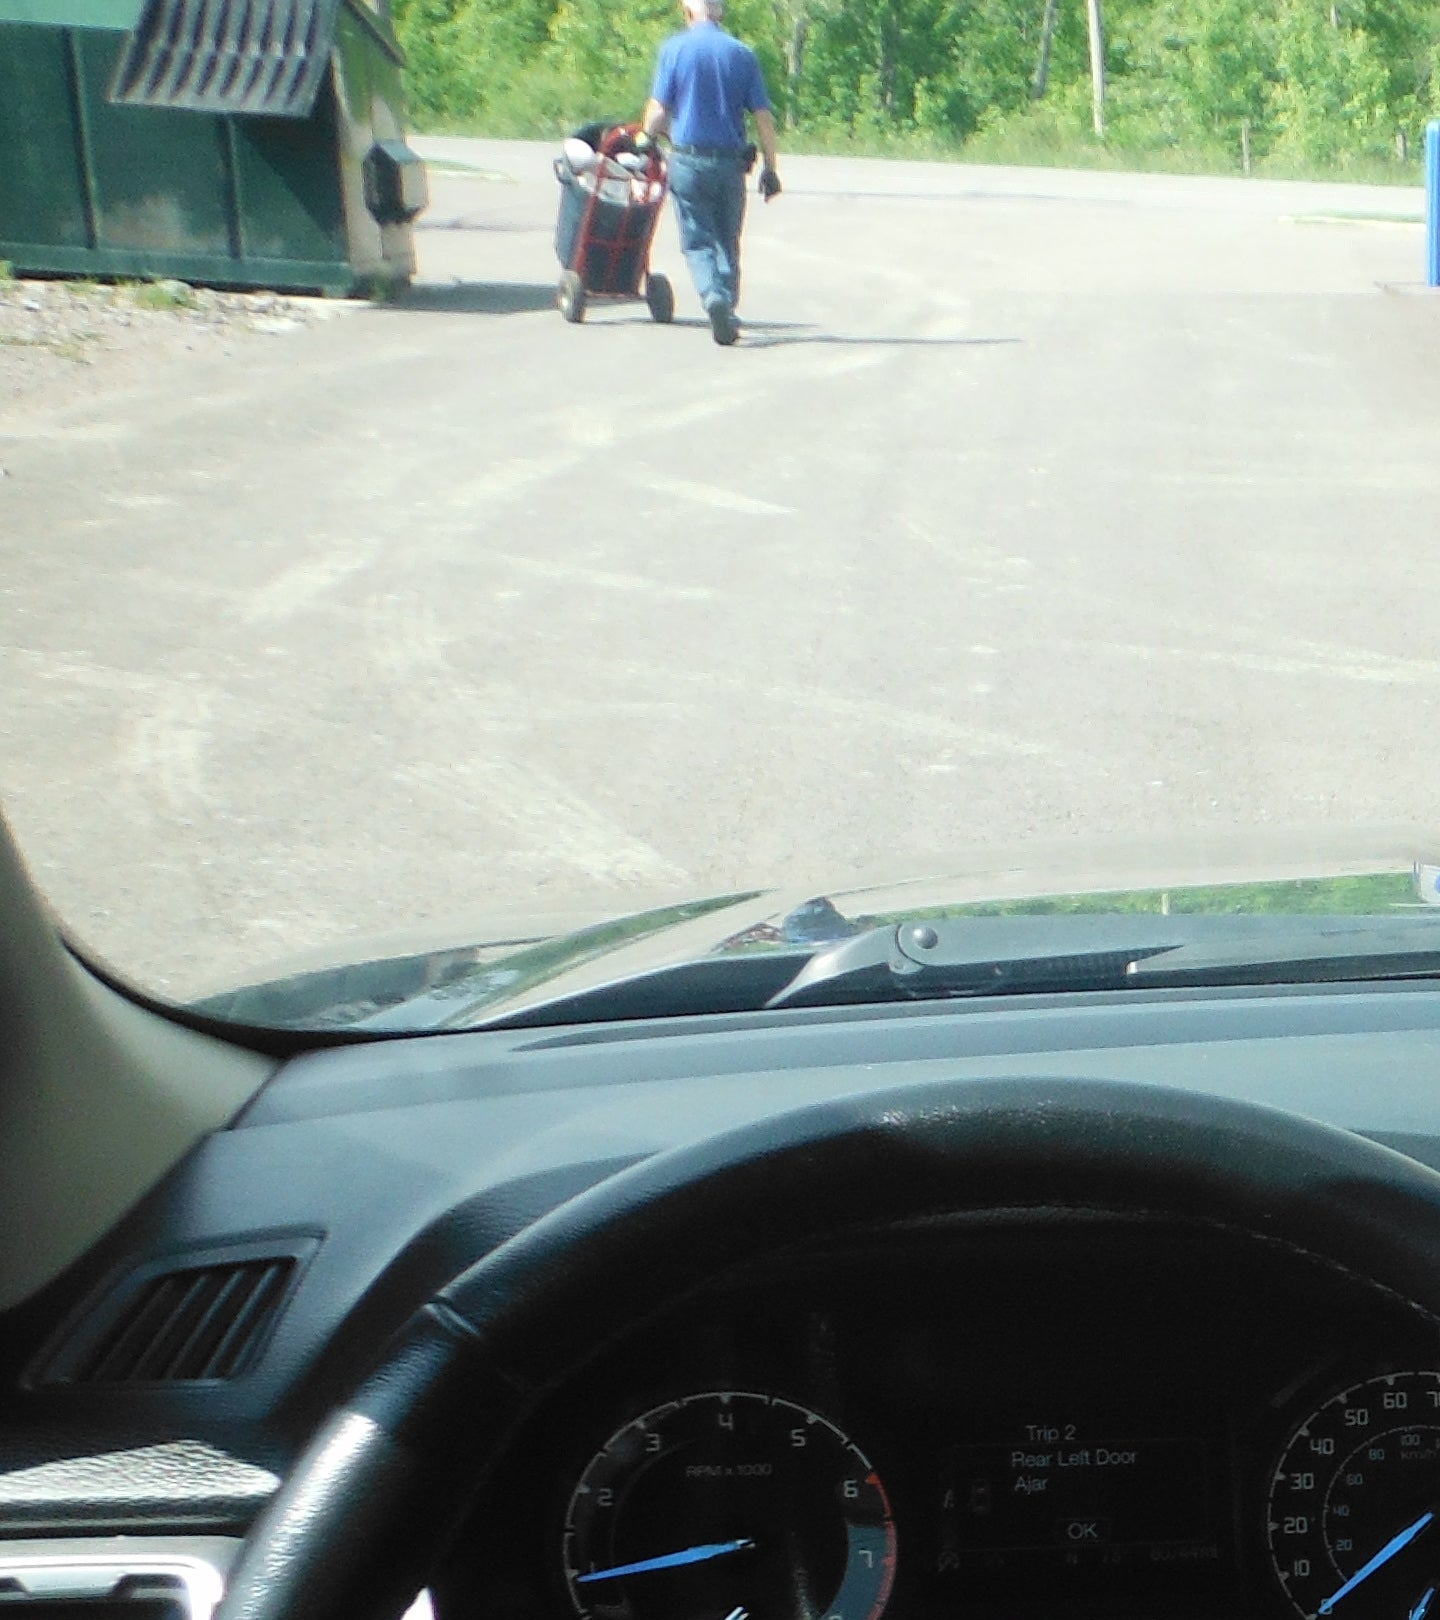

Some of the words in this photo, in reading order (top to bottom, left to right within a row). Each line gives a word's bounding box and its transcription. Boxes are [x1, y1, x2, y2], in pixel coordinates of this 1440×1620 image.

[1383, 1392, 1407, 1408] 60
[719, 1413, 734, 1430] 4
[1344, 1409, 1368, 1426] 50
[645, 1433, 660, 1451] 3
[790, 1428, 806, 1447] 5
[1025, 1424, 1058, 1443] Trip
[1064, 1424, 1077, 1441] 2
[1309, 1438, 1334, 1454] 40
[1011, 1450, 1053, 1467] Rear
[1058, 1449, 1090, 1466] Left
[1096, 1448, 1138, 1465] Door
[843, 1479, 859, 1498] 6
[1014, 1476, 1048, 1495] Ajar
[1290, 1473, 1314, 1489] 30
[598, 1488, 614, 1506] 2
[1067, 1521, 1098, 1539] OK
[1284, 1517, 1307, 1534] 20
[859, 1549, 873, 1568] 7
[1293, 1560, 1310, 1576] 10
